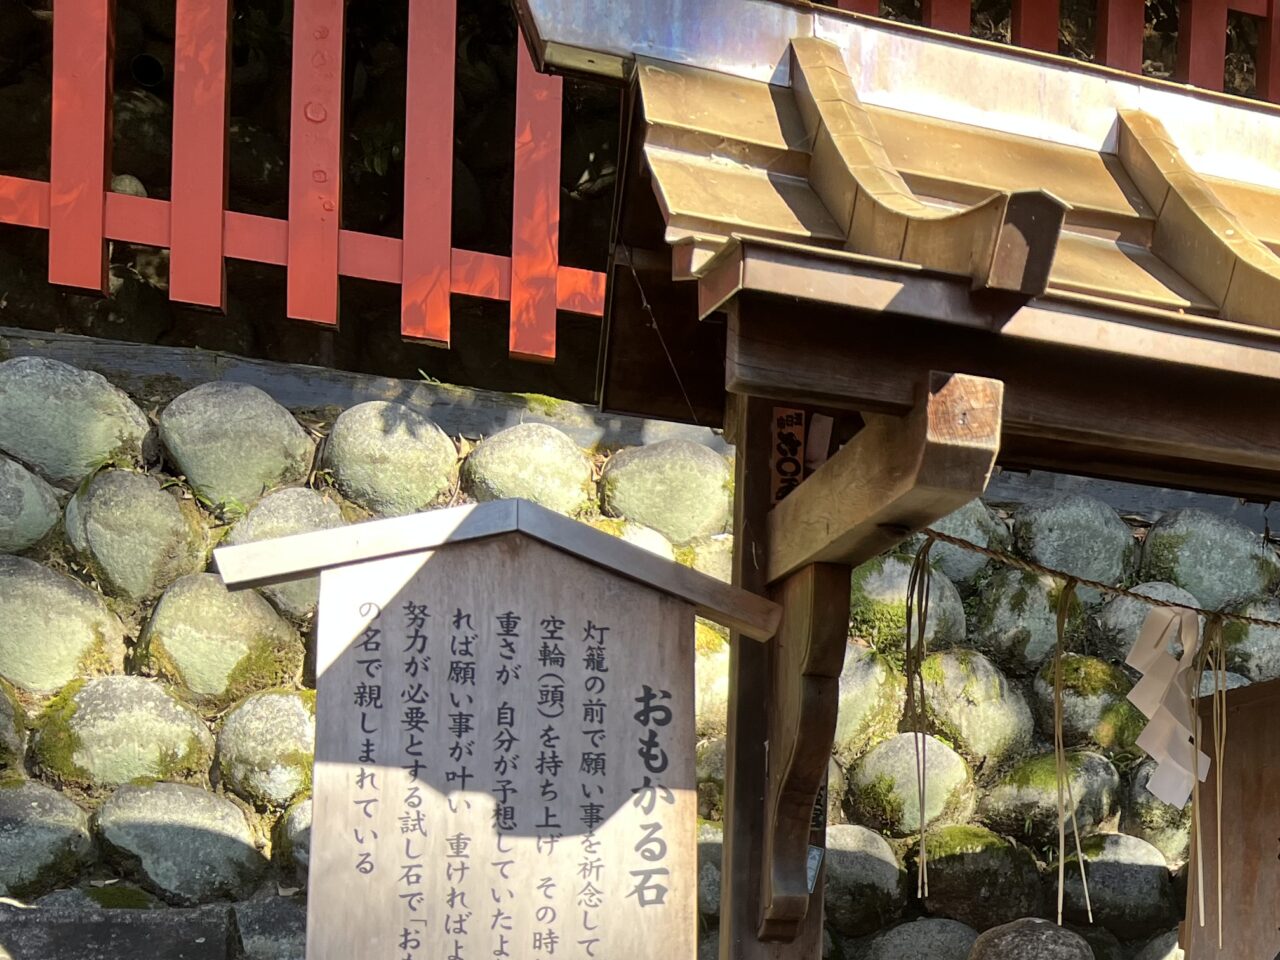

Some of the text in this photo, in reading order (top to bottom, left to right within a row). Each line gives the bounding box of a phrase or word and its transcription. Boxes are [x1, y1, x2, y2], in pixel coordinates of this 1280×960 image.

[353, 601, 384, 875] の名で親しまれている
[444, 607, 479, 814] れば願い事が叶い
[495, 610, 522, 686] 重さが
[625, 684, 676, 908] おもかる石
